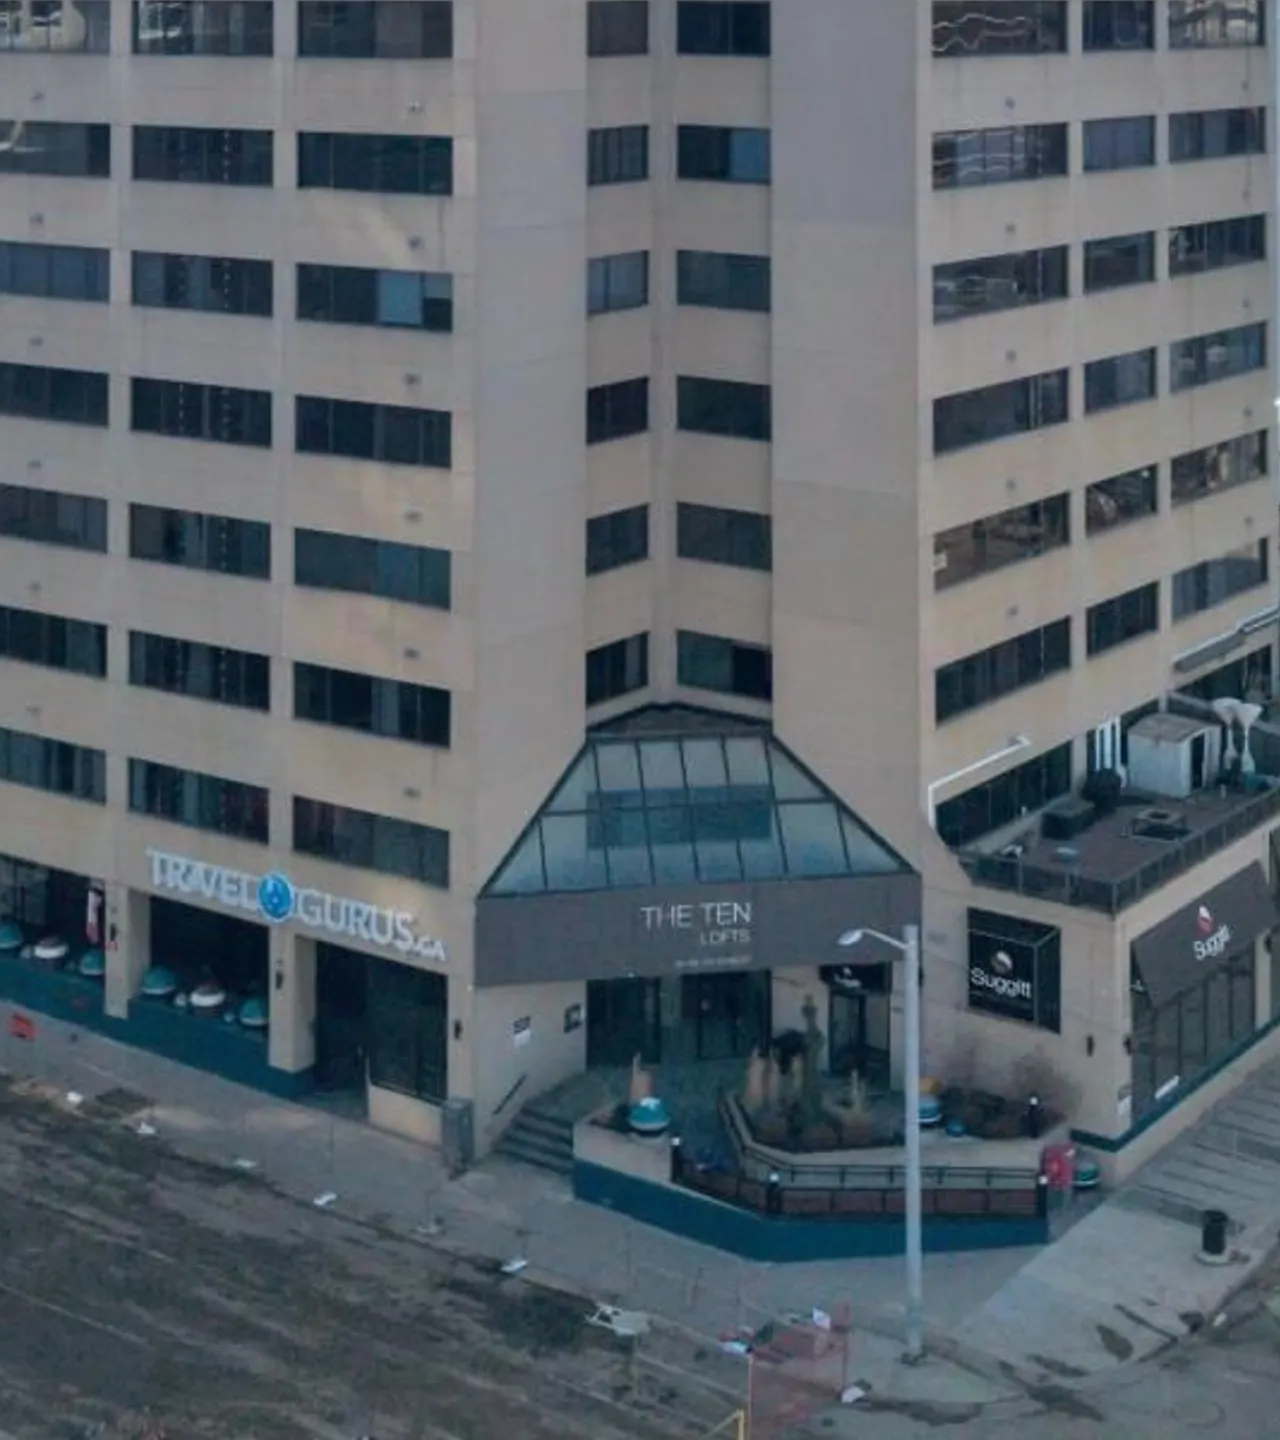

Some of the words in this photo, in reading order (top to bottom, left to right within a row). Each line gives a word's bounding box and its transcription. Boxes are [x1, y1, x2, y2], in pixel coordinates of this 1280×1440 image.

[145, 846, 261, 910] TRAVEL
[639, 904, 695, 930] THE
[699, 901, 752, 926] TEN
[970, 966, 1032, 1000] Suggitt
